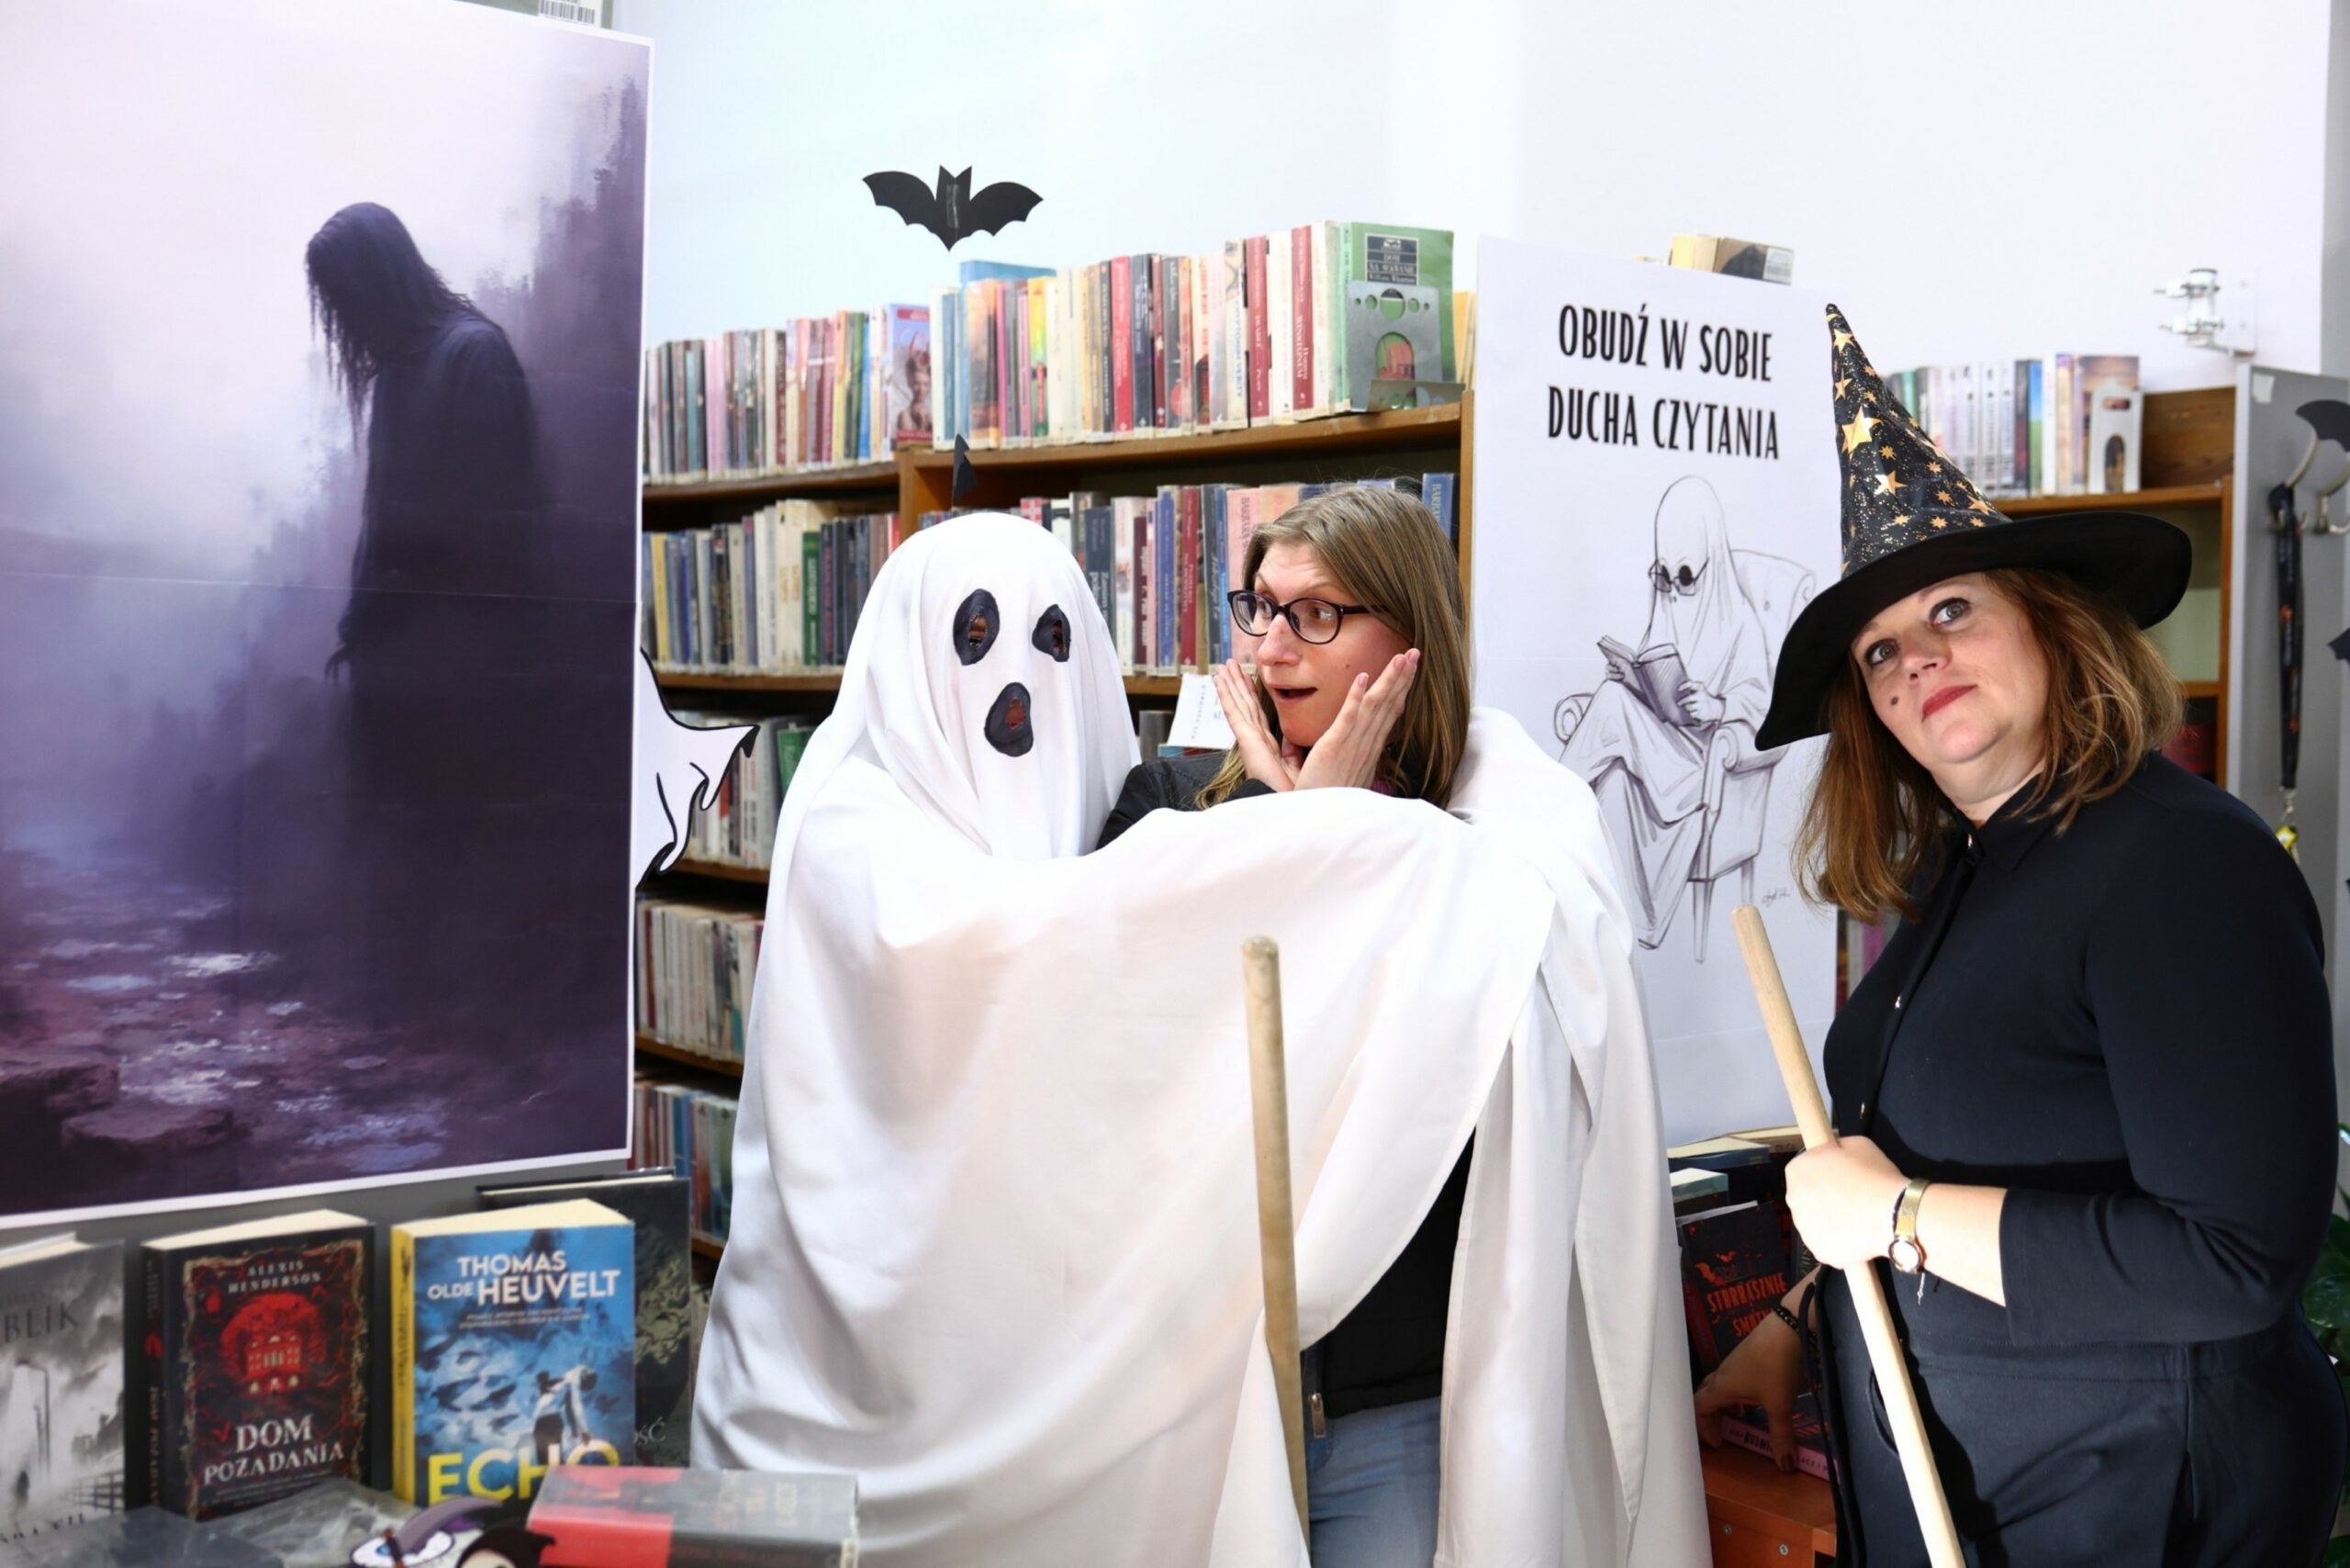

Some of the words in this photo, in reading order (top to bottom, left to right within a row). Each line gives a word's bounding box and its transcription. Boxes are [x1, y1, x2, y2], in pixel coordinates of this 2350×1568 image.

[1559, 303, 1650, 367] OBUDŹ
[1660, 318, 1688, 371] W
[1699, 324, 1773, 382] SOBIE
[1548, 385, 1639, 446] DUCHA
[1653, 398, 1779, 460] CZYTANIA
[247, 1260, 304, 1277] ALEXIS
[457, 1249, 566, 1278] THOMAS
[228, 1271, 321, 1294] HENDERSON
[426, 1282, 474, 1301] OLDE
[477, 1269, 621, 1306] HEUVELT
[235, 1413, 314, 1453] DOM
